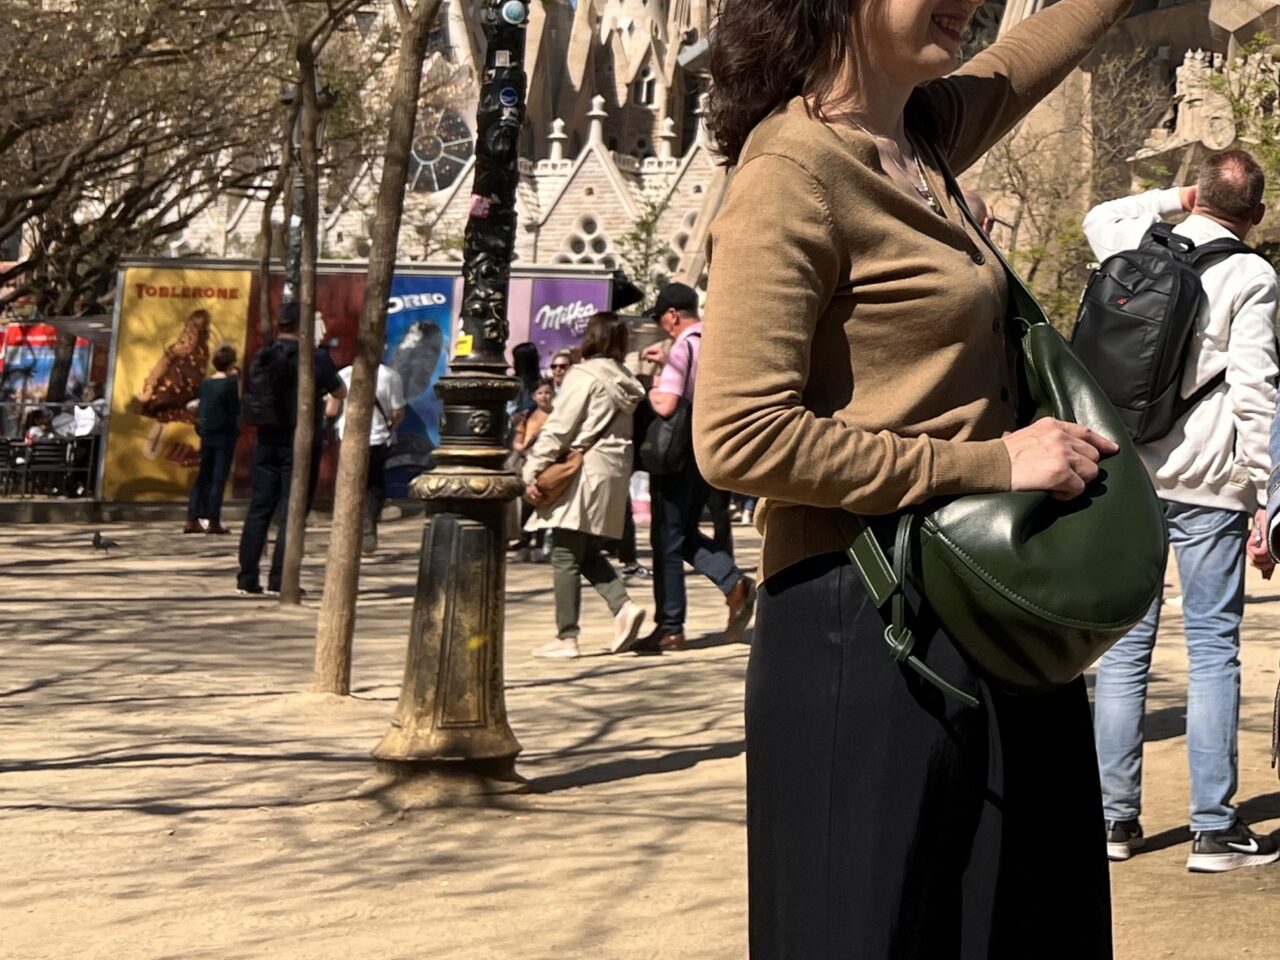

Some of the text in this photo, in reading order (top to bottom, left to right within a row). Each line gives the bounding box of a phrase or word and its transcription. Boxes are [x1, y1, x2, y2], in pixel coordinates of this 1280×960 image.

[135, 283, 239, 300] TOBLERONE
[387, 293, 446, 314] OREO
[535, 300, 598, 330] Milka
